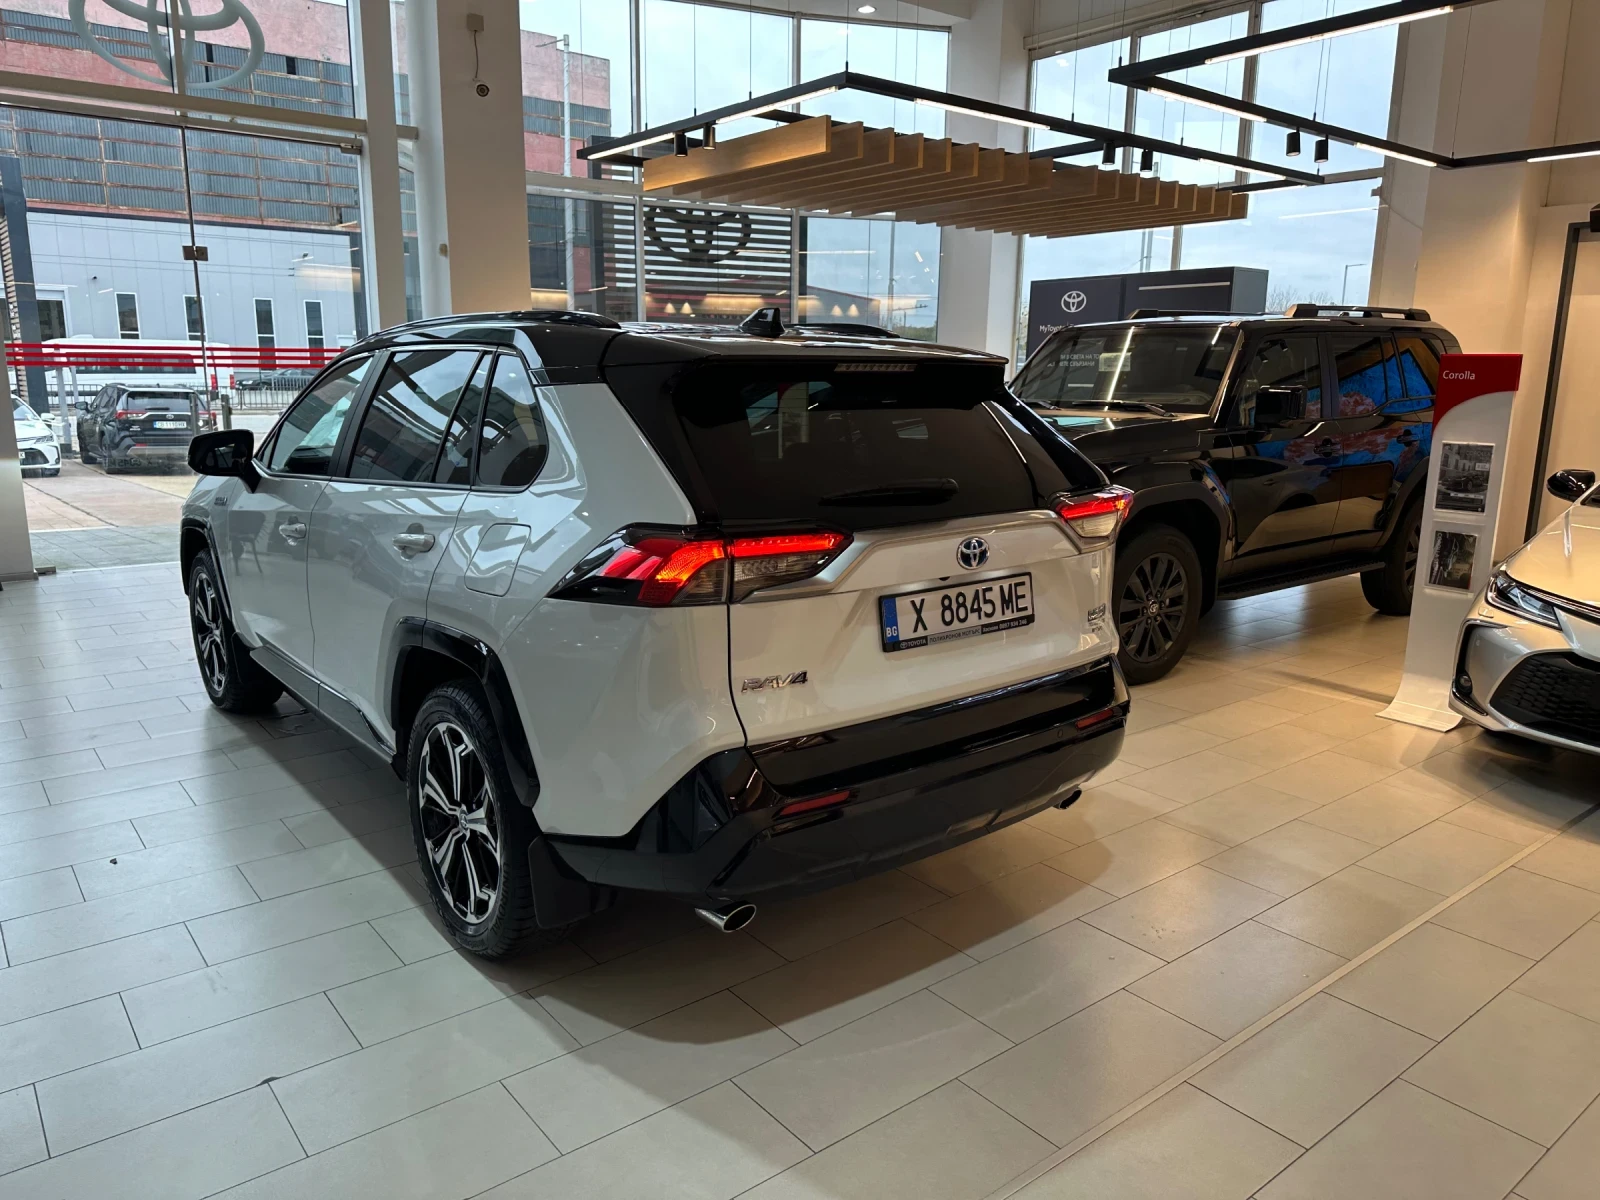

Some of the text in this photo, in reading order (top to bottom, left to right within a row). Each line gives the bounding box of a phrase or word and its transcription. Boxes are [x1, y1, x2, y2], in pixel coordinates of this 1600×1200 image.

[1442, 370, 1476, 380] Corolla
[910, 581, 1029, 633] X 8845 ME
[886, 625, 898, 638] BG
[907, 639, 927, 647] TOYOTA
[741, 670, 808, 692] RAV4
[490, 861, 512, 935] UNIROYAL
